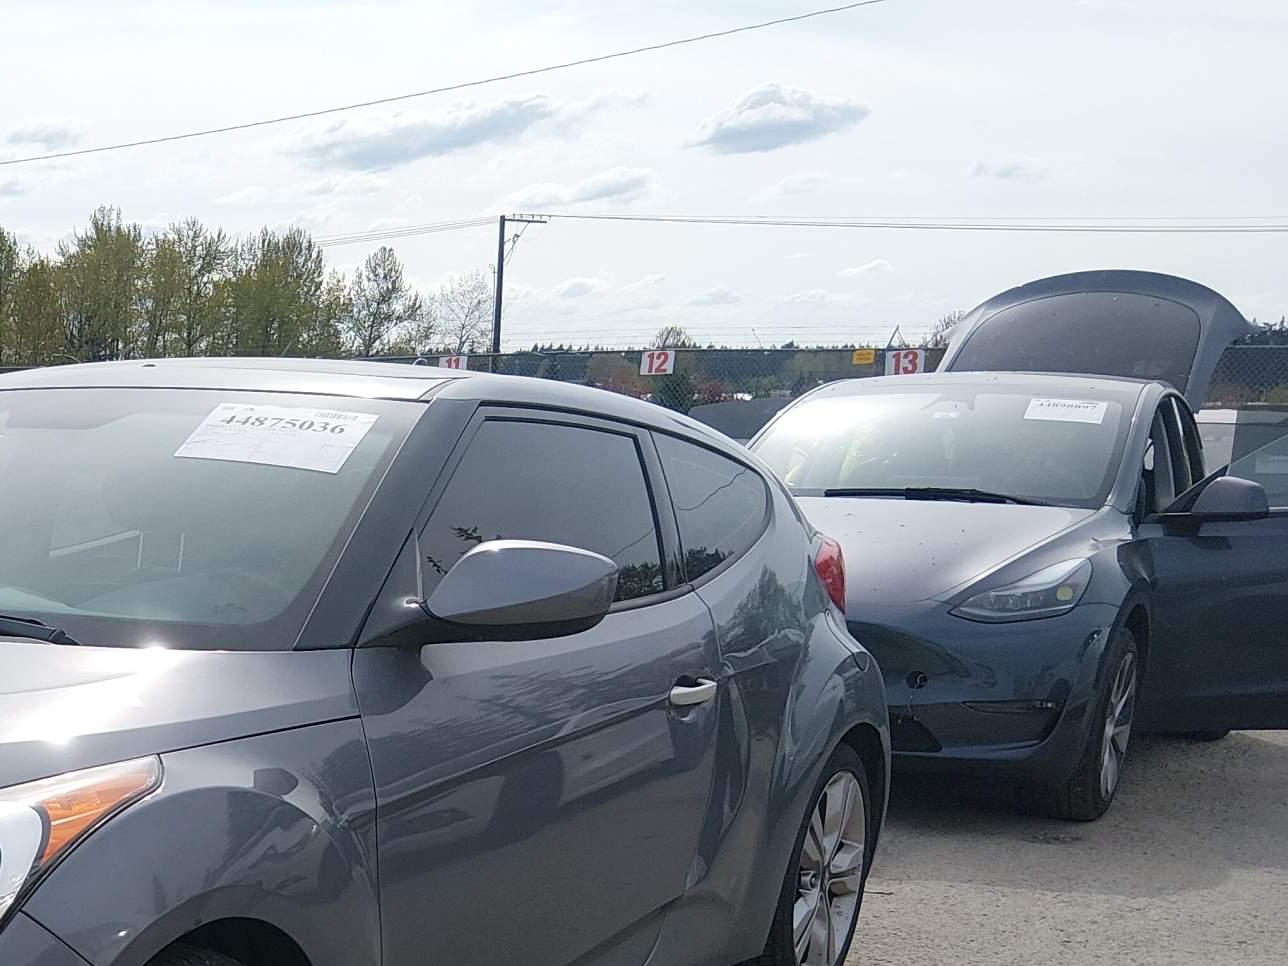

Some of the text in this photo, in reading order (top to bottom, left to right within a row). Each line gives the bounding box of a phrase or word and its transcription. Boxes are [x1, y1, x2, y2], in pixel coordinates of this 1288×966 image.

[647, 351, 669, 374] 12
[892, 350, 919, 375] 13
[220, 414, 346, 435] 44875036
